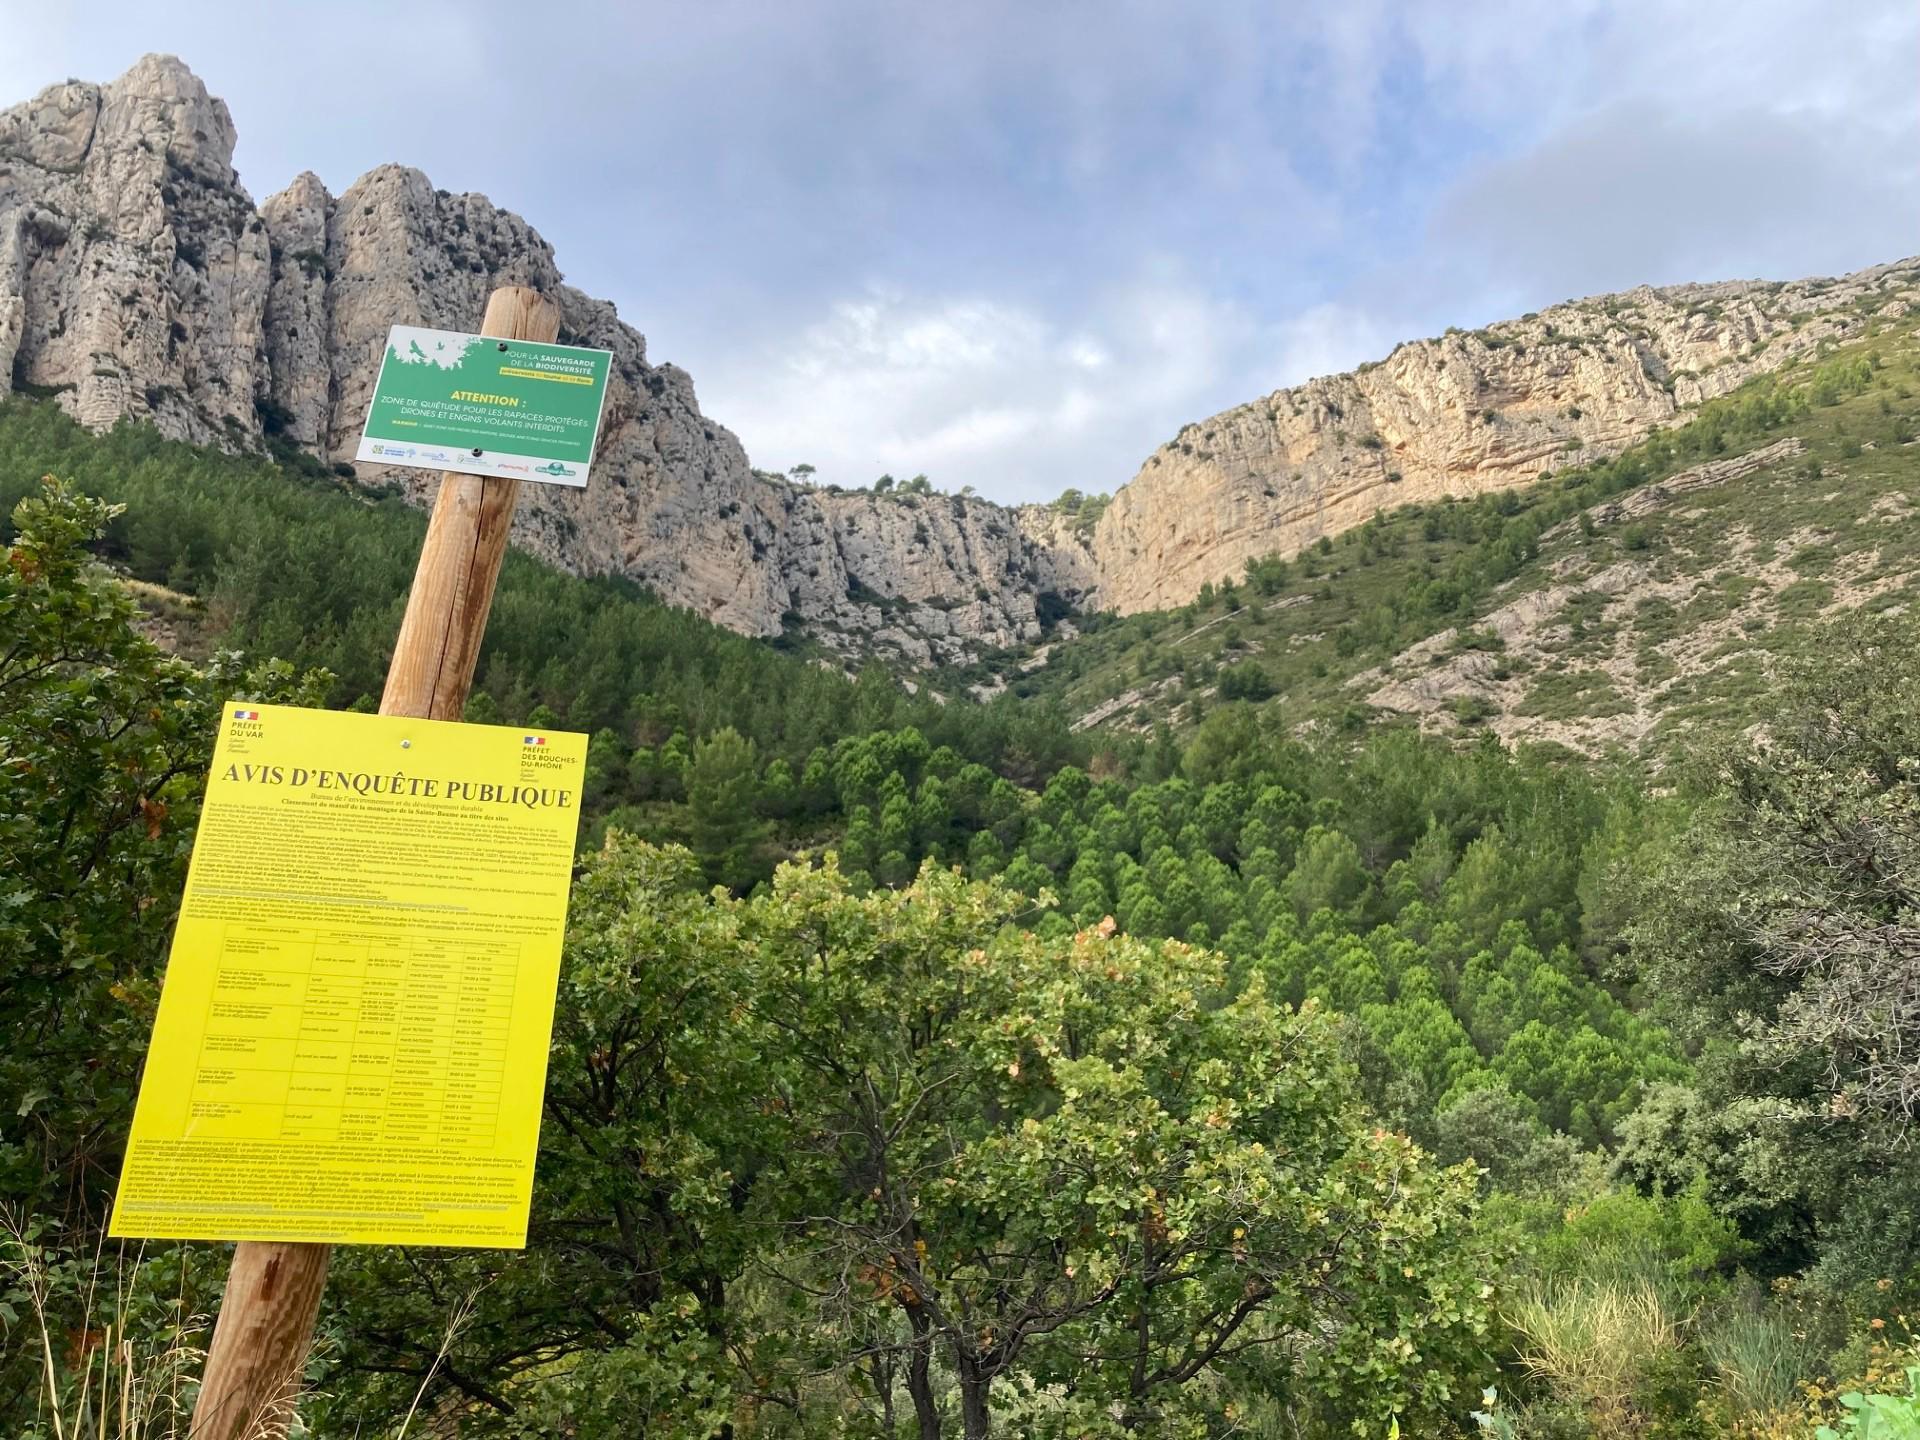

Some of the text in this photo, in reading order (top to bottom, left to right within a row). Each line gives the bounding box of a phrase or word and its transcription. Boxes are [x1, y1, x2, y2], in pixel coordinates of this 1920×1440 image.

[505, 350, 528, 359] POUR
[541, 354, 595, 367] SAUVEGARDE
[451, 391, 518, 406] ATTENTION
[381, 395, 589, 427] ZONE DE QUIÉTUDE POUR LES RAPACES PROTÉGÉS
[401, 406, 565, 432] DRONES ET ENGINS VOLANTS INTERDITS
[232, 721, 264, 730] PRÉFET
[230, 728, 264, 738] DU VAR
[523, 745, 551, 754] PRÉFET
[539, 754, 578, 763] BOUCHES-
[521, 760, 563, 770] DU-RHÔNE
[222, 764, 284, 784] AVIS
[445, 782, 571, 809] PUBLIQUE
